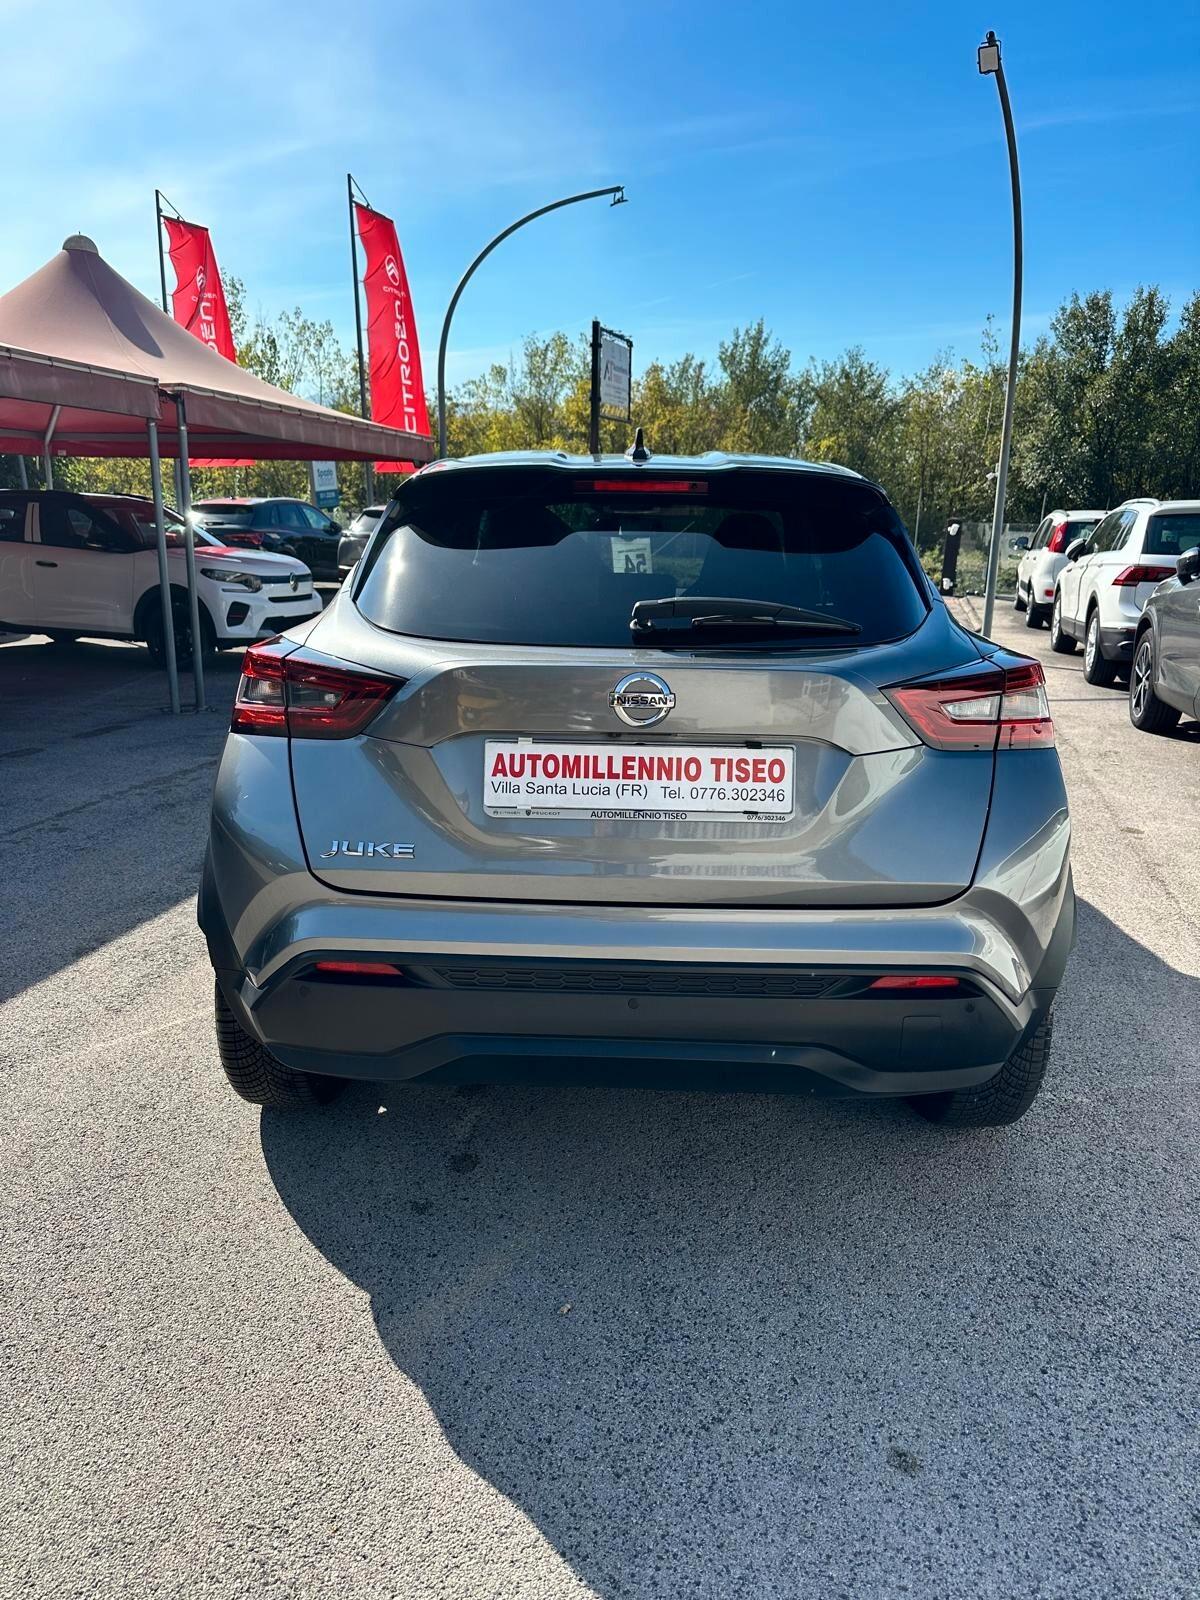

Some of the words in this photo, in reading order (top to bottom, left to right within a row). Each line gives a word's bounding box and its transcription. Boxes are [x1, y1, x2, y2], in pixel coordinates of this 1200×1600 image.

[616, 696, 667, 705] NISSAN
[491, 753, 702, 782] AUTOMILLENNIO
[710, 757, 786, 784] TISEO
[491, 781, 520, 794] Villa
[525, 781, 567, 795] Santa
[572, 782, 610, 796] Lucia
[615, 783, 648, 799] (FR)
[661, 786, 685, 799] Tel.
[690, 787, 785, 802] 0776.302346
[590, 811, 662, 820] AUTOMILLENNIO
[662, 812, 687, 820] TISEO
[746, 814, 786, 822] 0776/302346
[320, 840, 415, 859] JUKE
